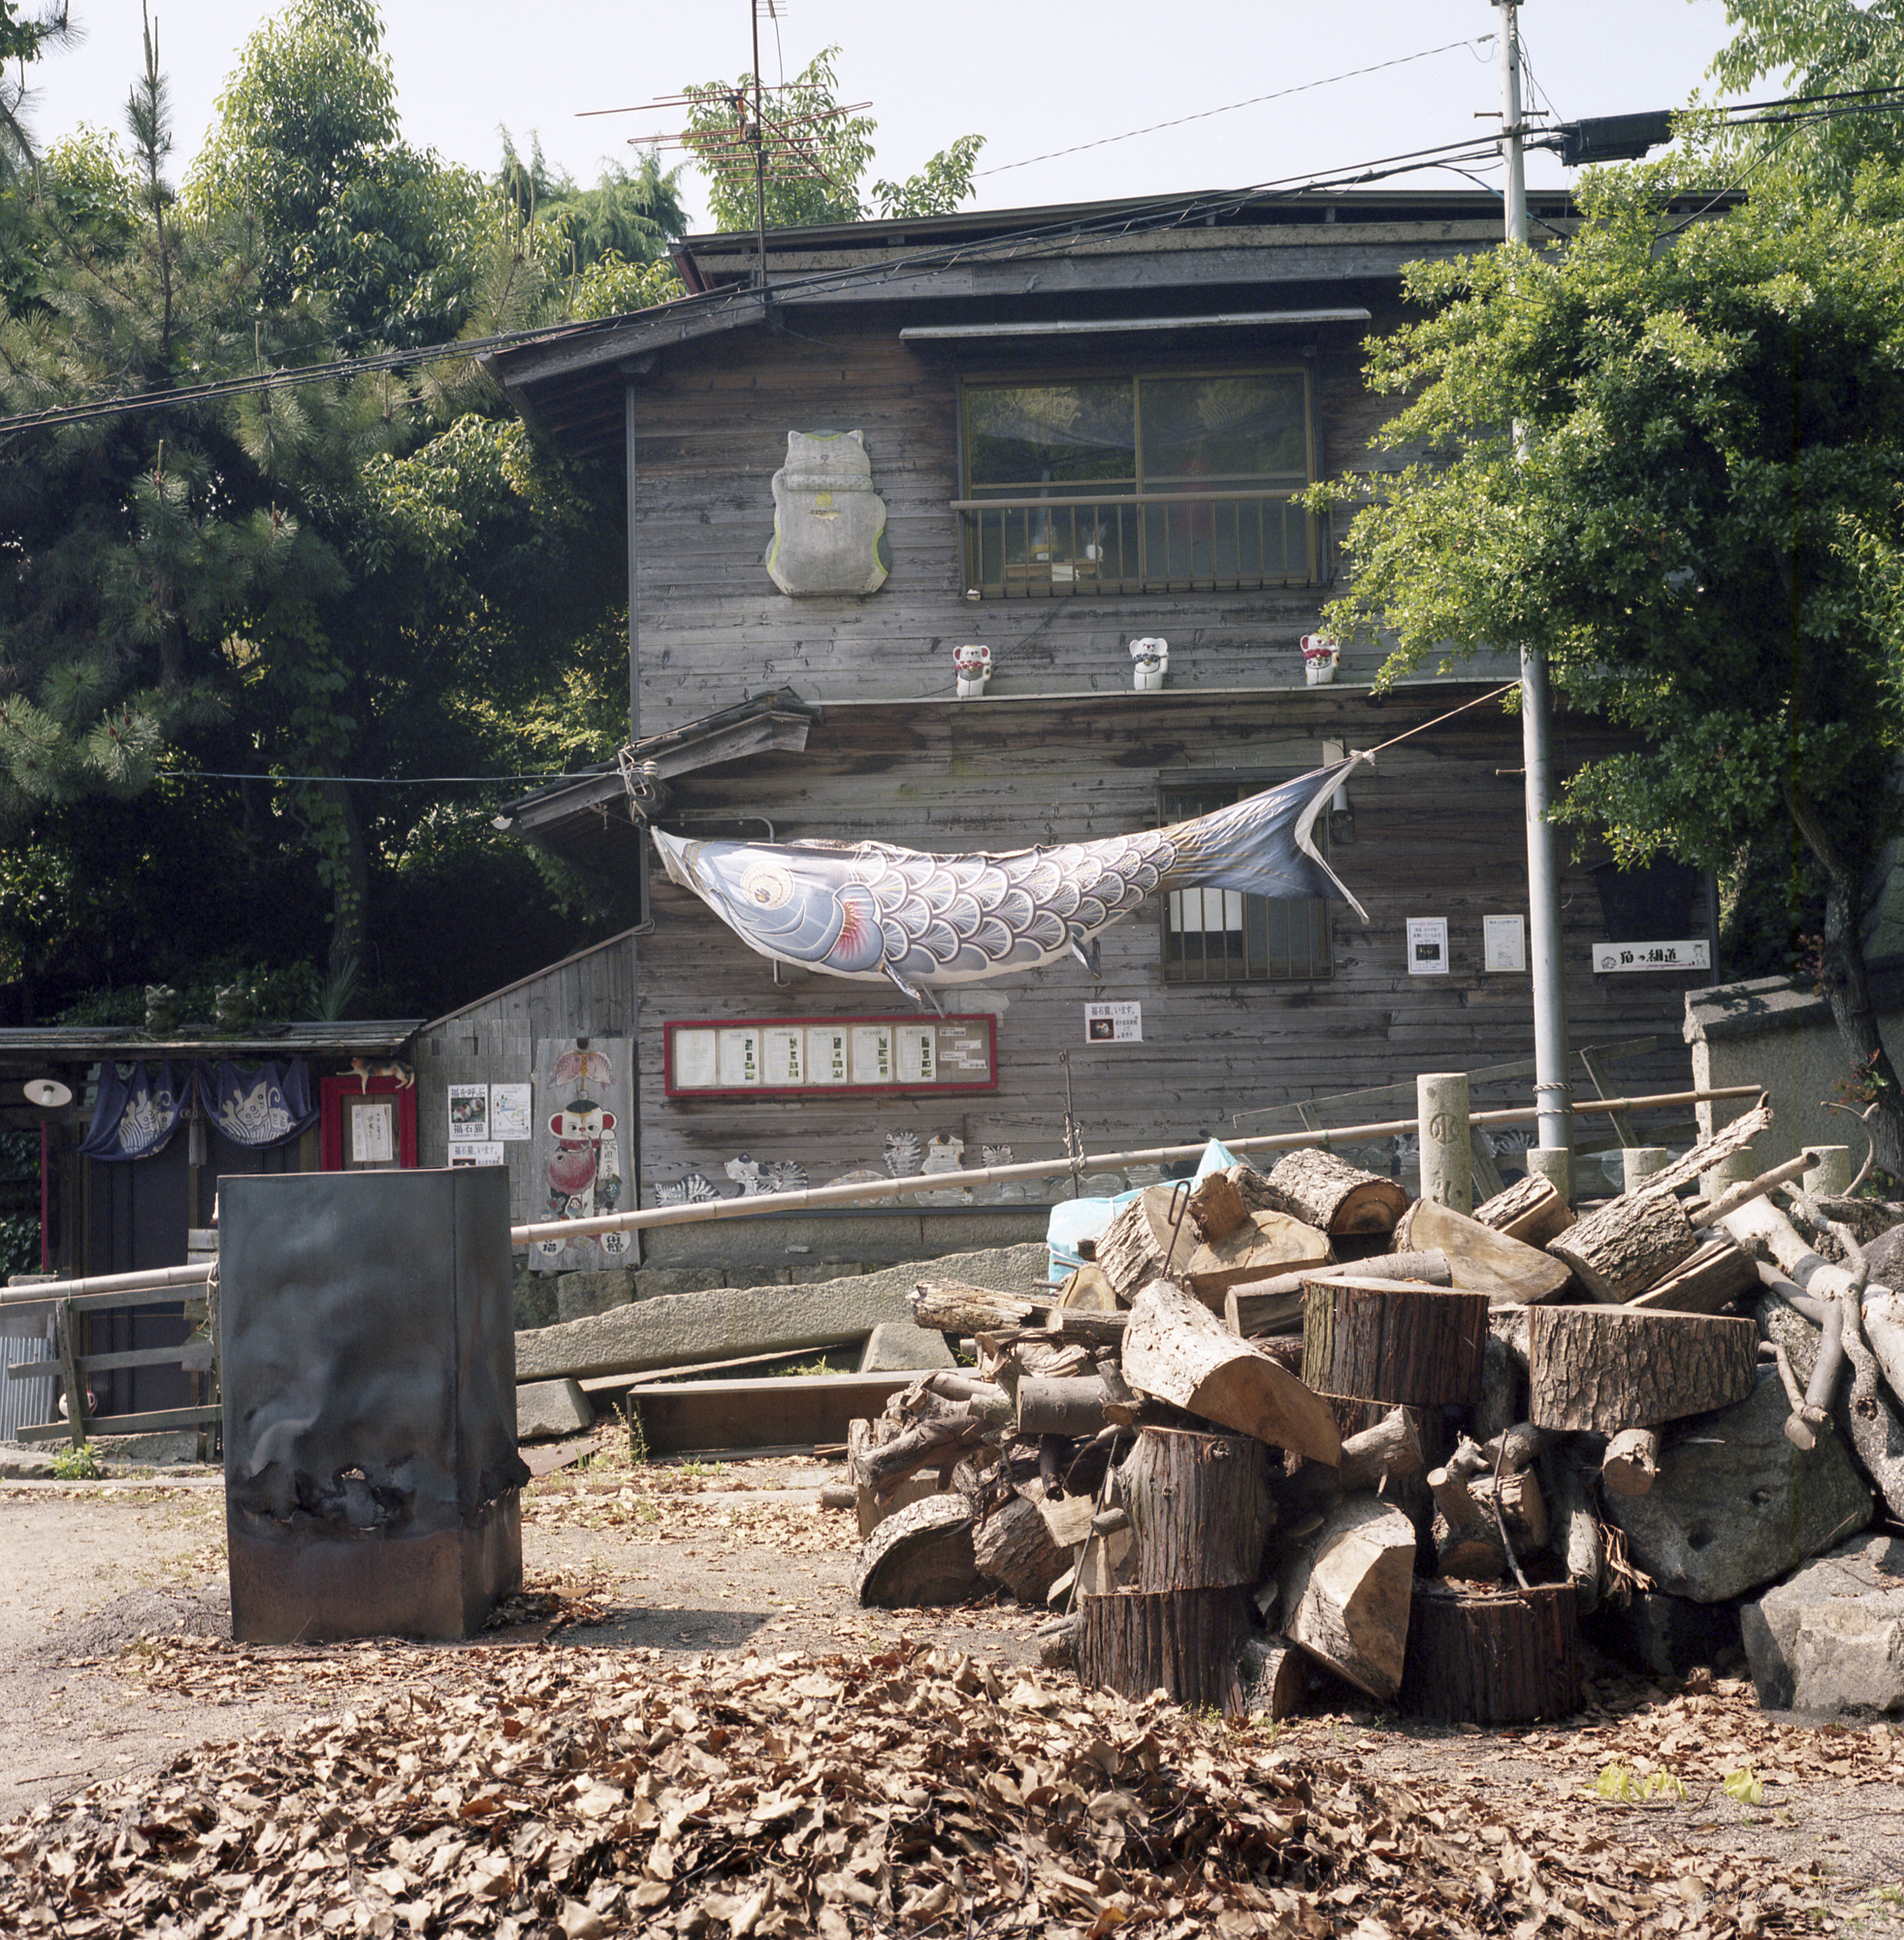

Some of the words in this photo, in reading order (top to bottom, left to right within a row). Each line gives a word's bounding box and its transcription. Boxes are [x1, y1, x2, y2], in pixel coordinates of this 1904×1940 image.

[451, 1087, 485, 1097] 福を呼ぶ
[453, 1122, 484, 1133] 福石猫
